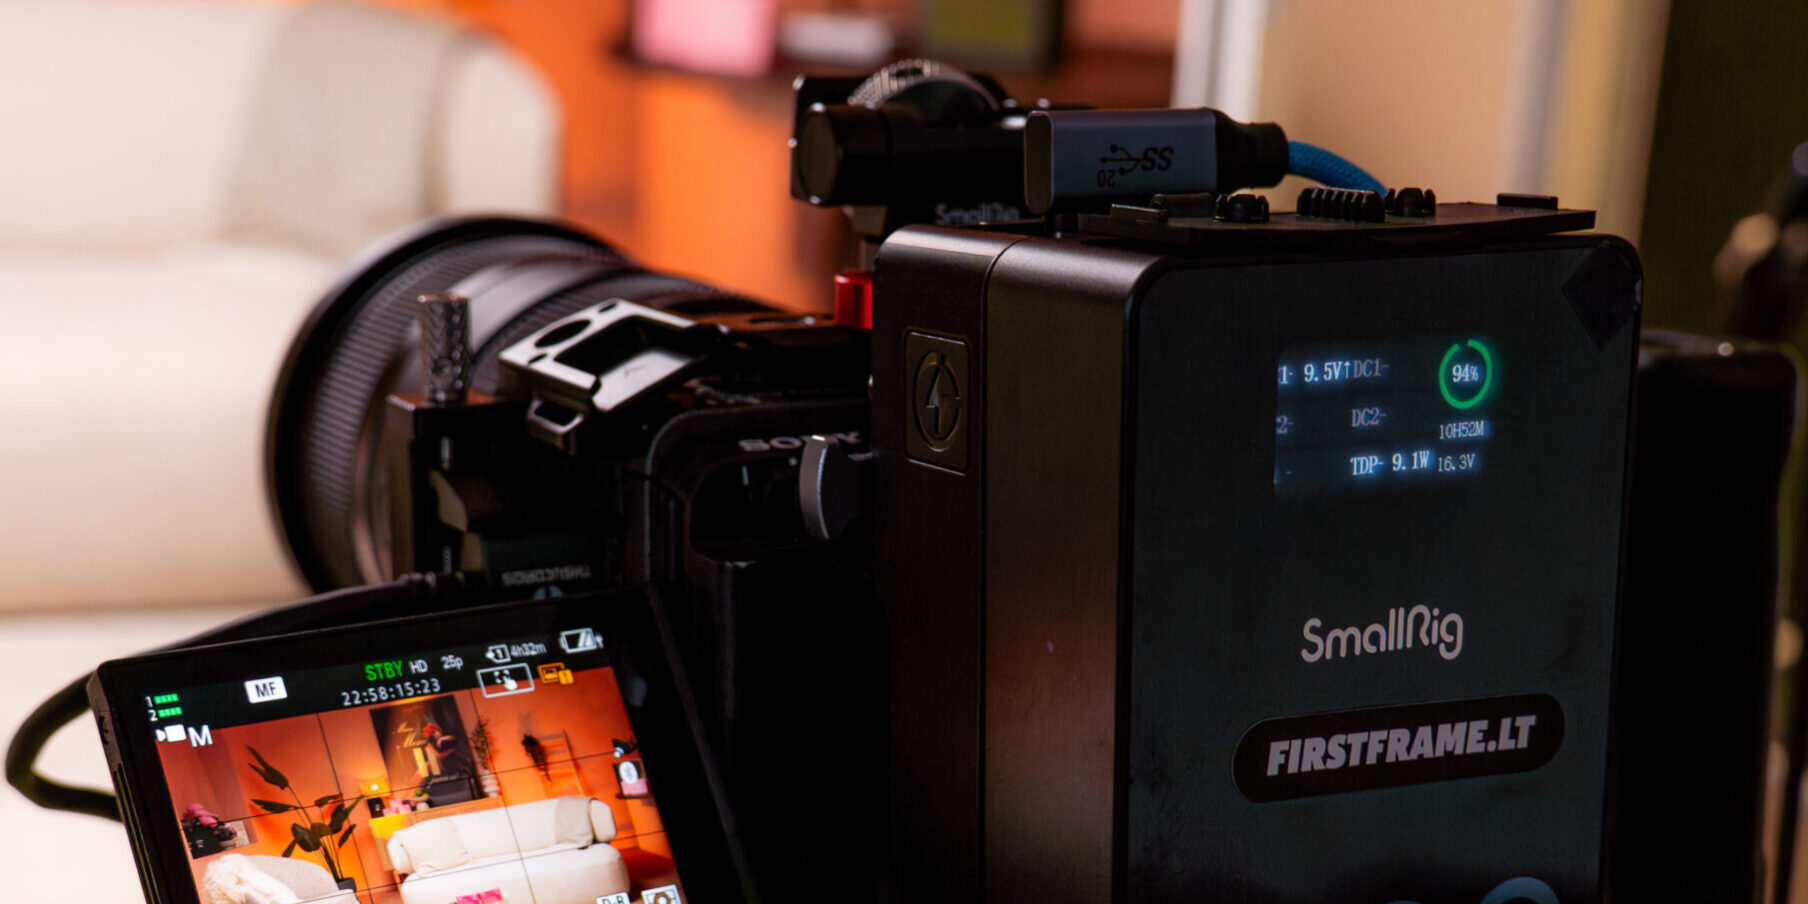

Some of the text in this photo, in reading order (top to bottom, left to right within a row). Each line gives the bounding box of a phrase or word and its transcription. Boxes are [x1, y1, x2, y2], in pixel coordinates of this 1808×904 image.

[1096, 168, 1116, 188] 20
[1352, 359, 1390, 378] DC1-
[1452, 364, 1479, 383] 94%
[1351, 407, 1387, 427] DC2-
[1439, 420, 1485, 440] 10H52M
[738, 431, 862, 452] SOY
[1350, 450, 1430, 476] TDP- 9.1W
[1438, 453, 1476, 473] 16.3V
[1300, 604, 1464, 664] SmallRig
[365, 655, 464, 682] STBY HD 25p
[254, 681, 277, 699] MF
[341, 677, 441, 707] 22:58:15:23
[188, 724, 214, 748] M
[1266, 714, 1537, 777] FIRSTFRAME.LT
